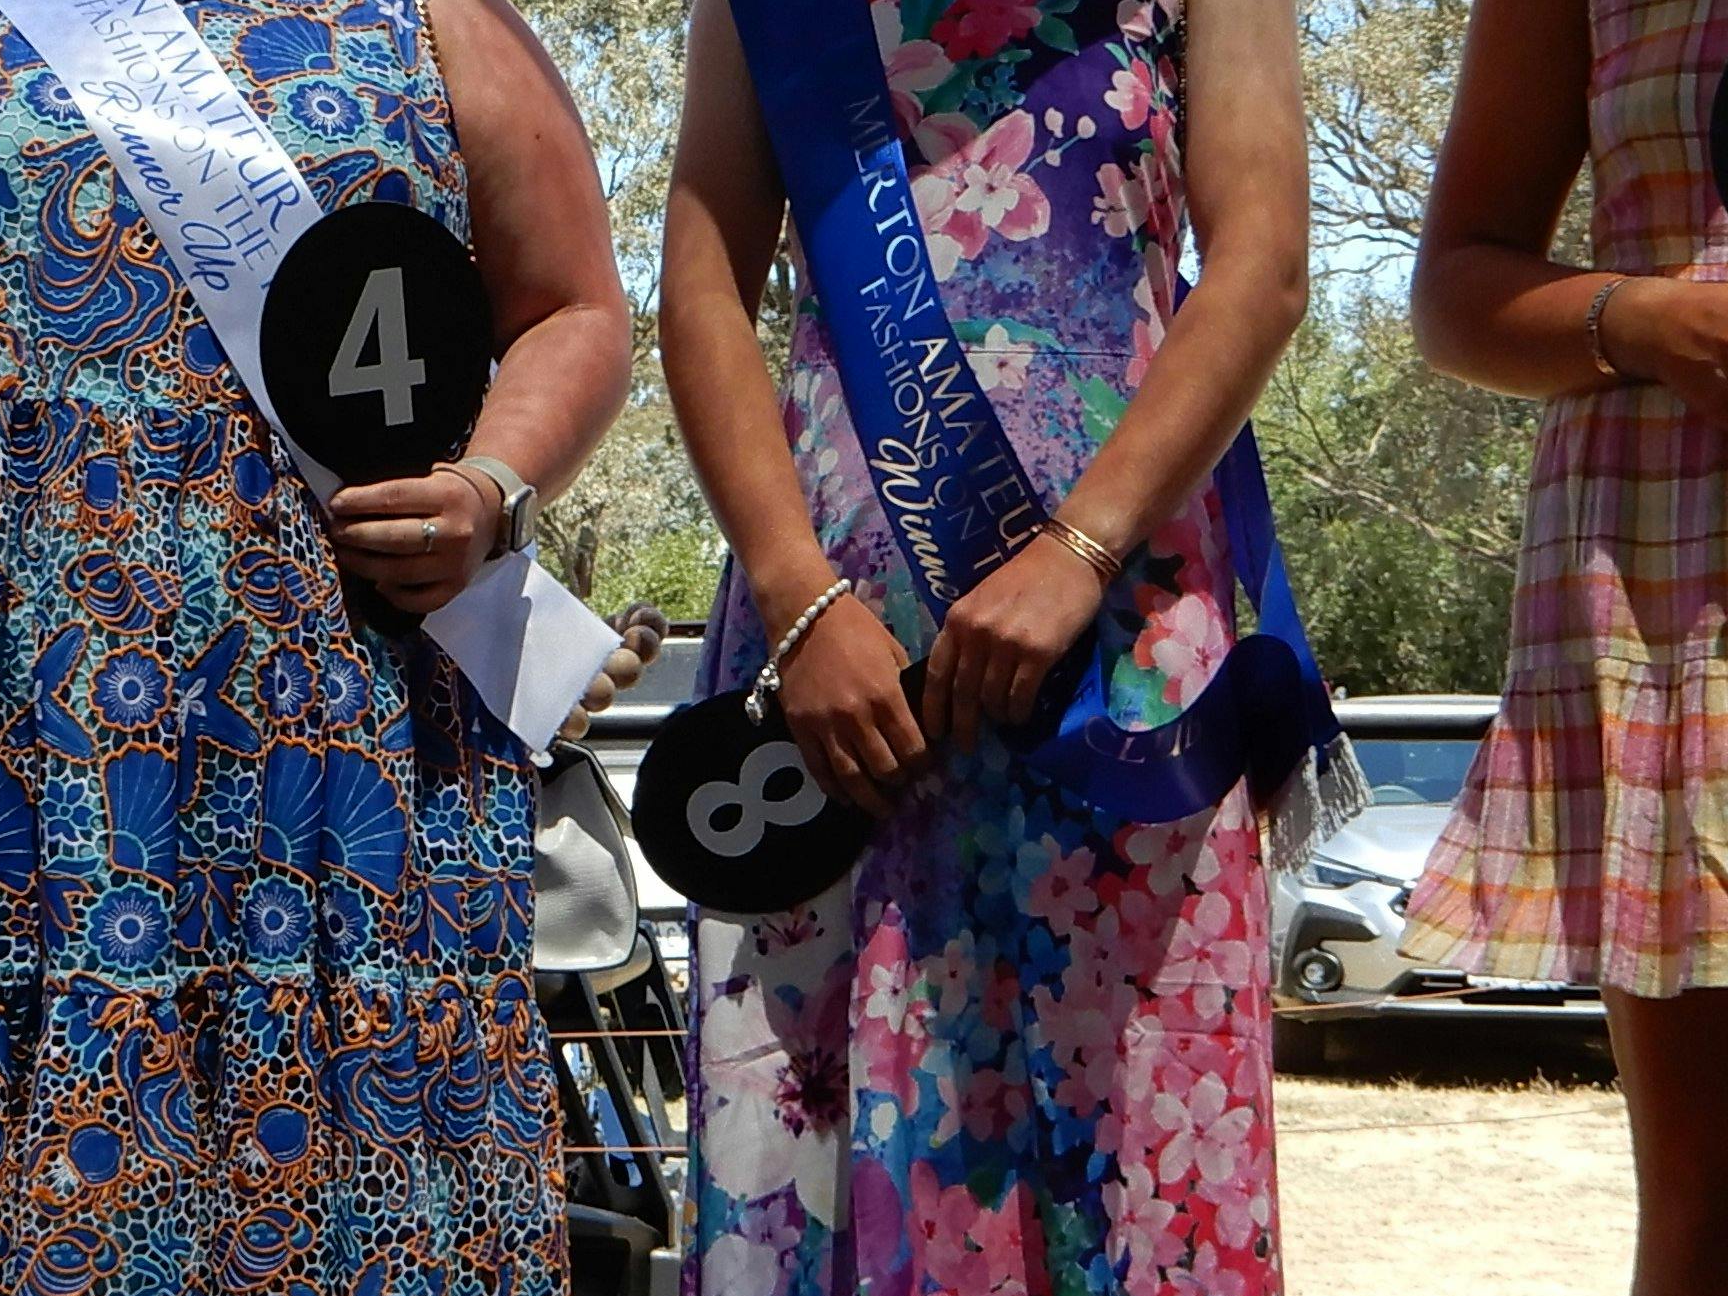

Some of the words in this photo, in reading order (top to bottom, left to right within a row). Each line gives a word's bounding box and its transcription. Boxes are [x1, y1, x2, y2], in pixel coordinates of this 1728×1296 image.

[80, 80, 183, 217] Runner
[180, 221, 237, 292] Up
[142, 29, 301, 234] AMATEUR
[172, 125, 229, 185] ON
[214, 184, 278, 271] THE
[329, 266, 426, 427] 4
[847, 94, 935, 321] MERTON
[909, 337, 1032, 551] AMATEU
[860, 276, 950, 470] FASHIONS
[934, 475, 985, 542] ON
[869, 437, 960, 602] Winne
[686, 740, 828, 858] 8
